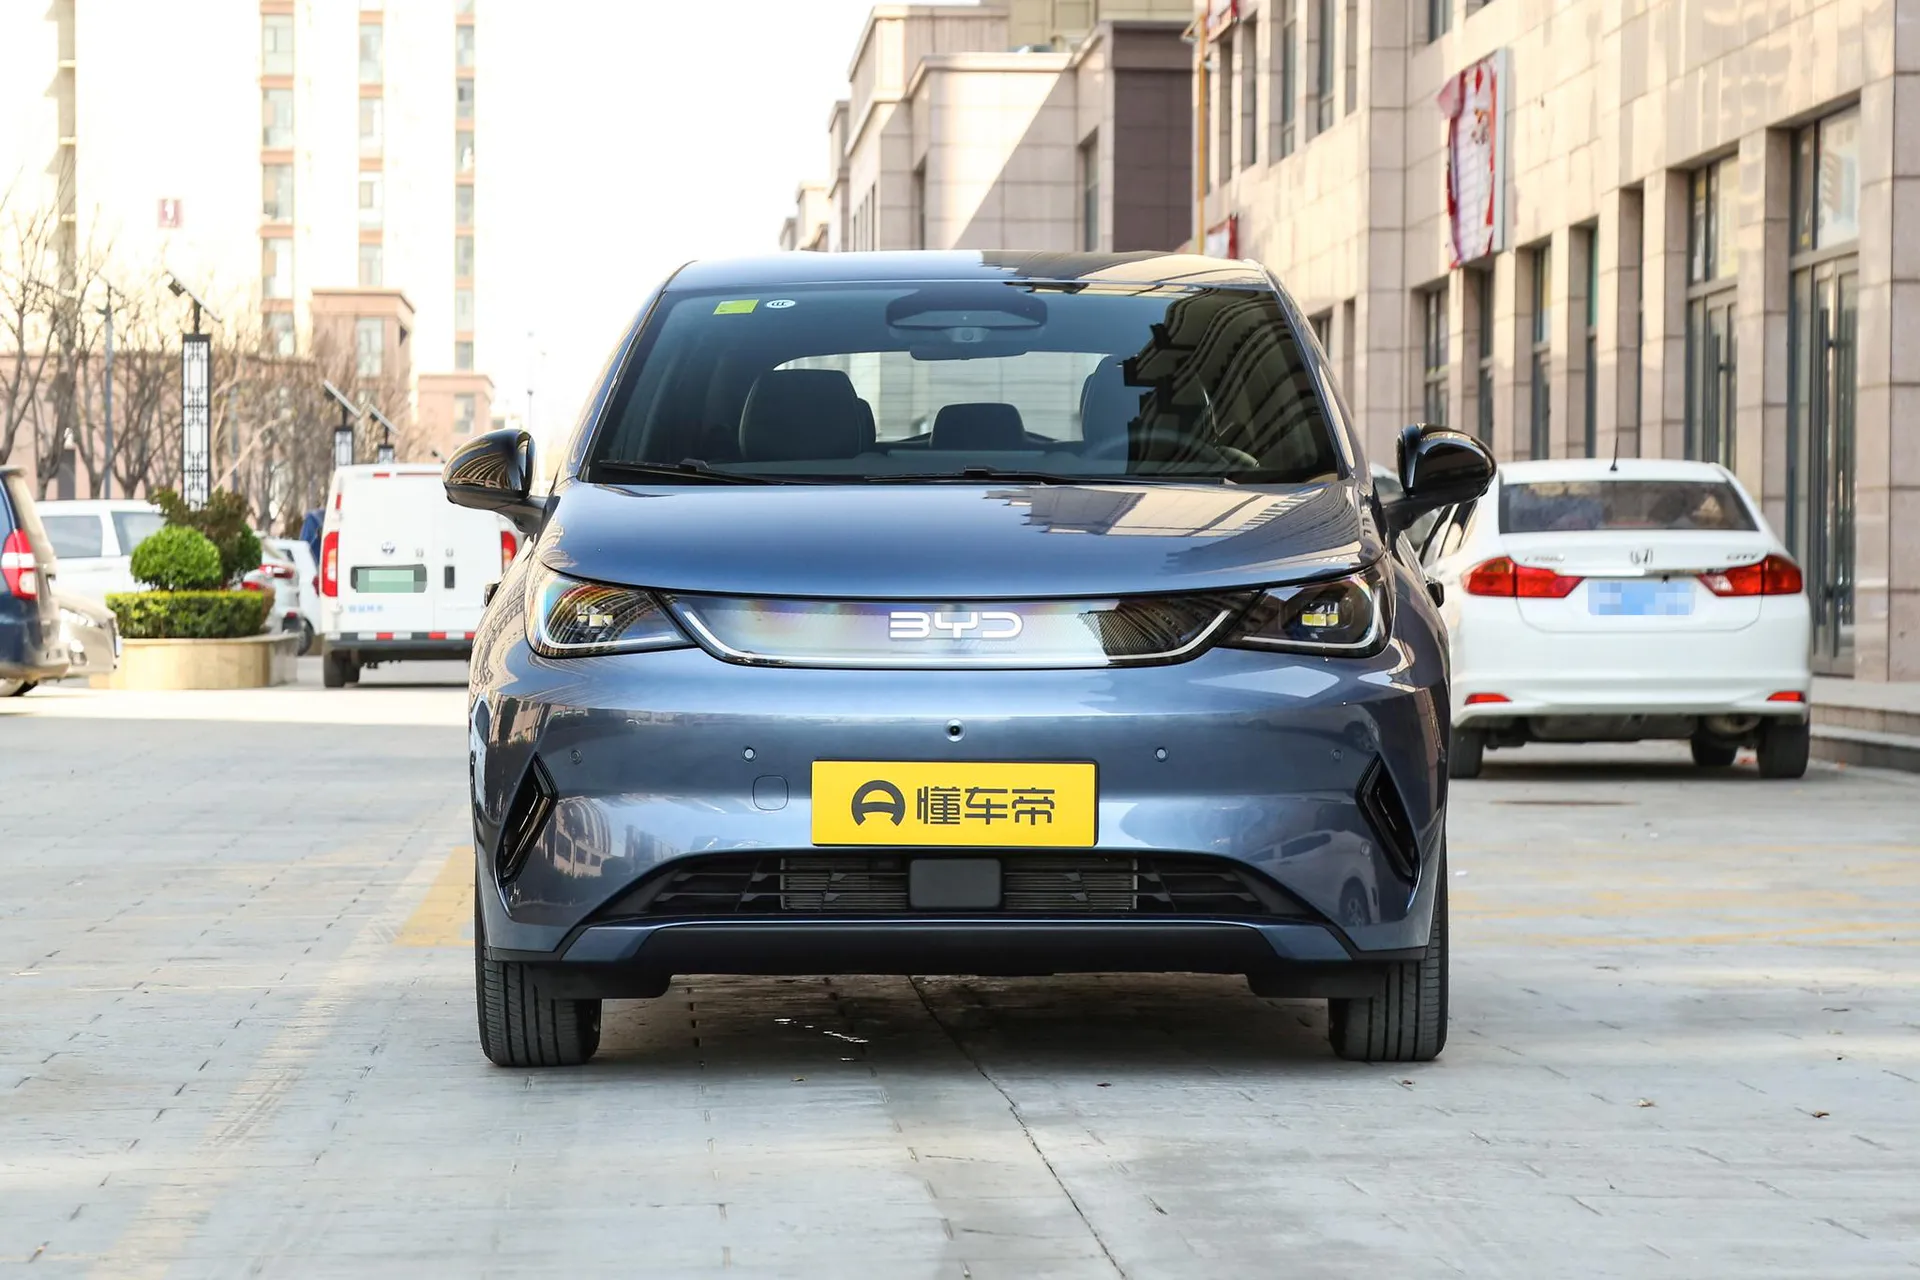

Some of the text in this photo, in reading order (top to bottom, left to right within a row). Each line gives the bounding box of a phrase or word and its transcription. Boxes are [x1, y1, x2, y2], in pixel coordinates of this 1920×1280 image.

[889, 611, 1024, 639] BYD
[917, 786, 1055, 825] 懂车帝
